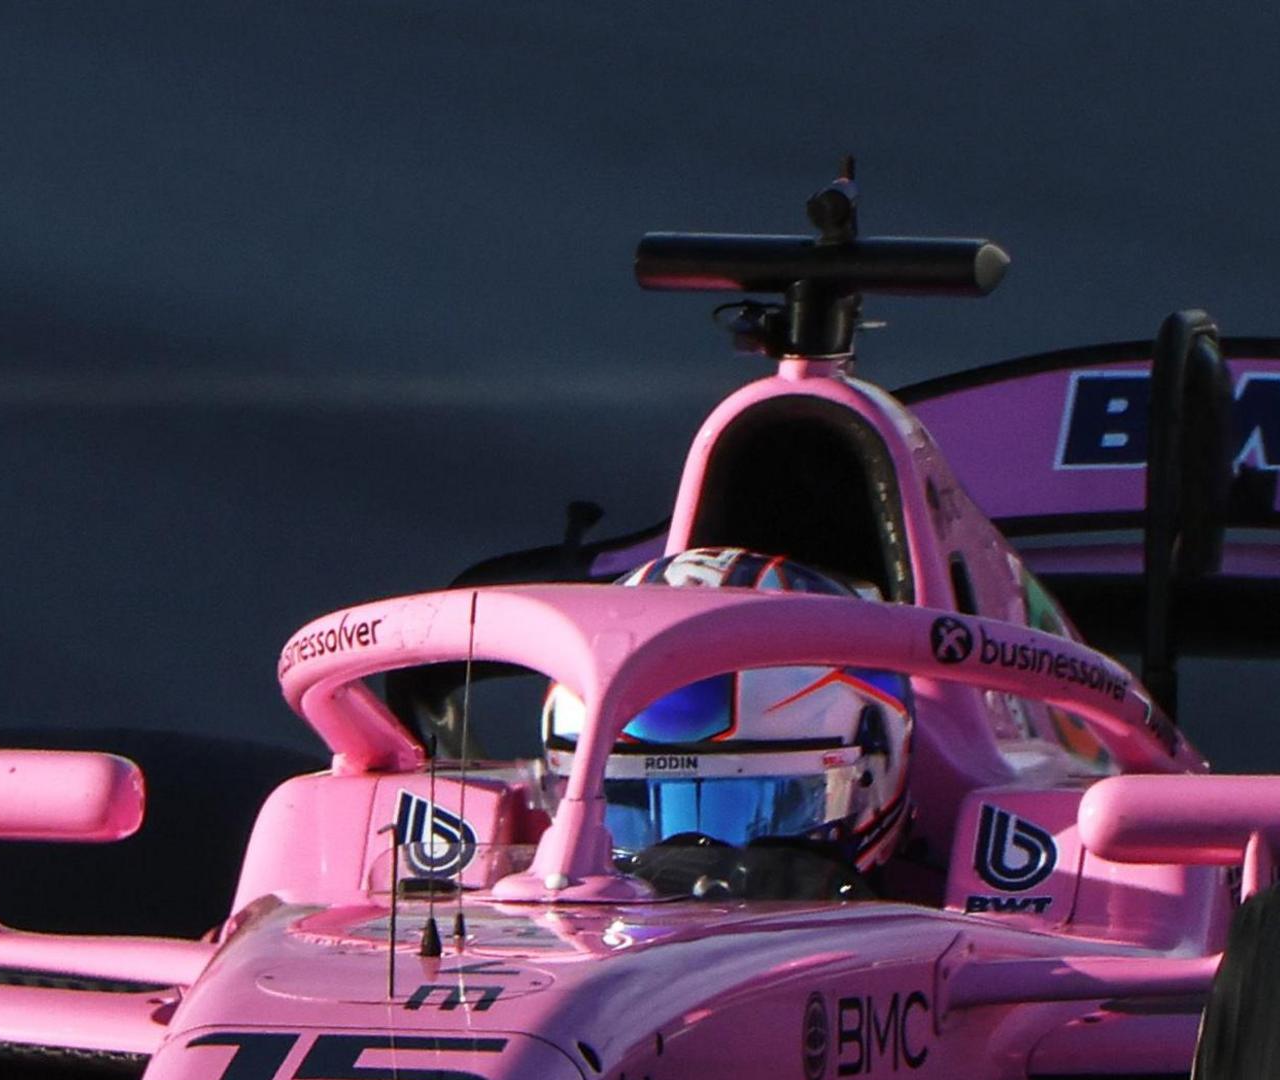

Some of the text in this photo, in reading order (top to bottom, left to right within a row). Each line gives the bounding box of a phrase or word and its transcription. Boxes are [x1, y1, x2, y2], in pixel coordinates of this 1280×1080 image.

[644, 756, 698, 770] RODIN
[964, 895, 1053, 915] BWT
[837, 989, 929, 1077] BMC
